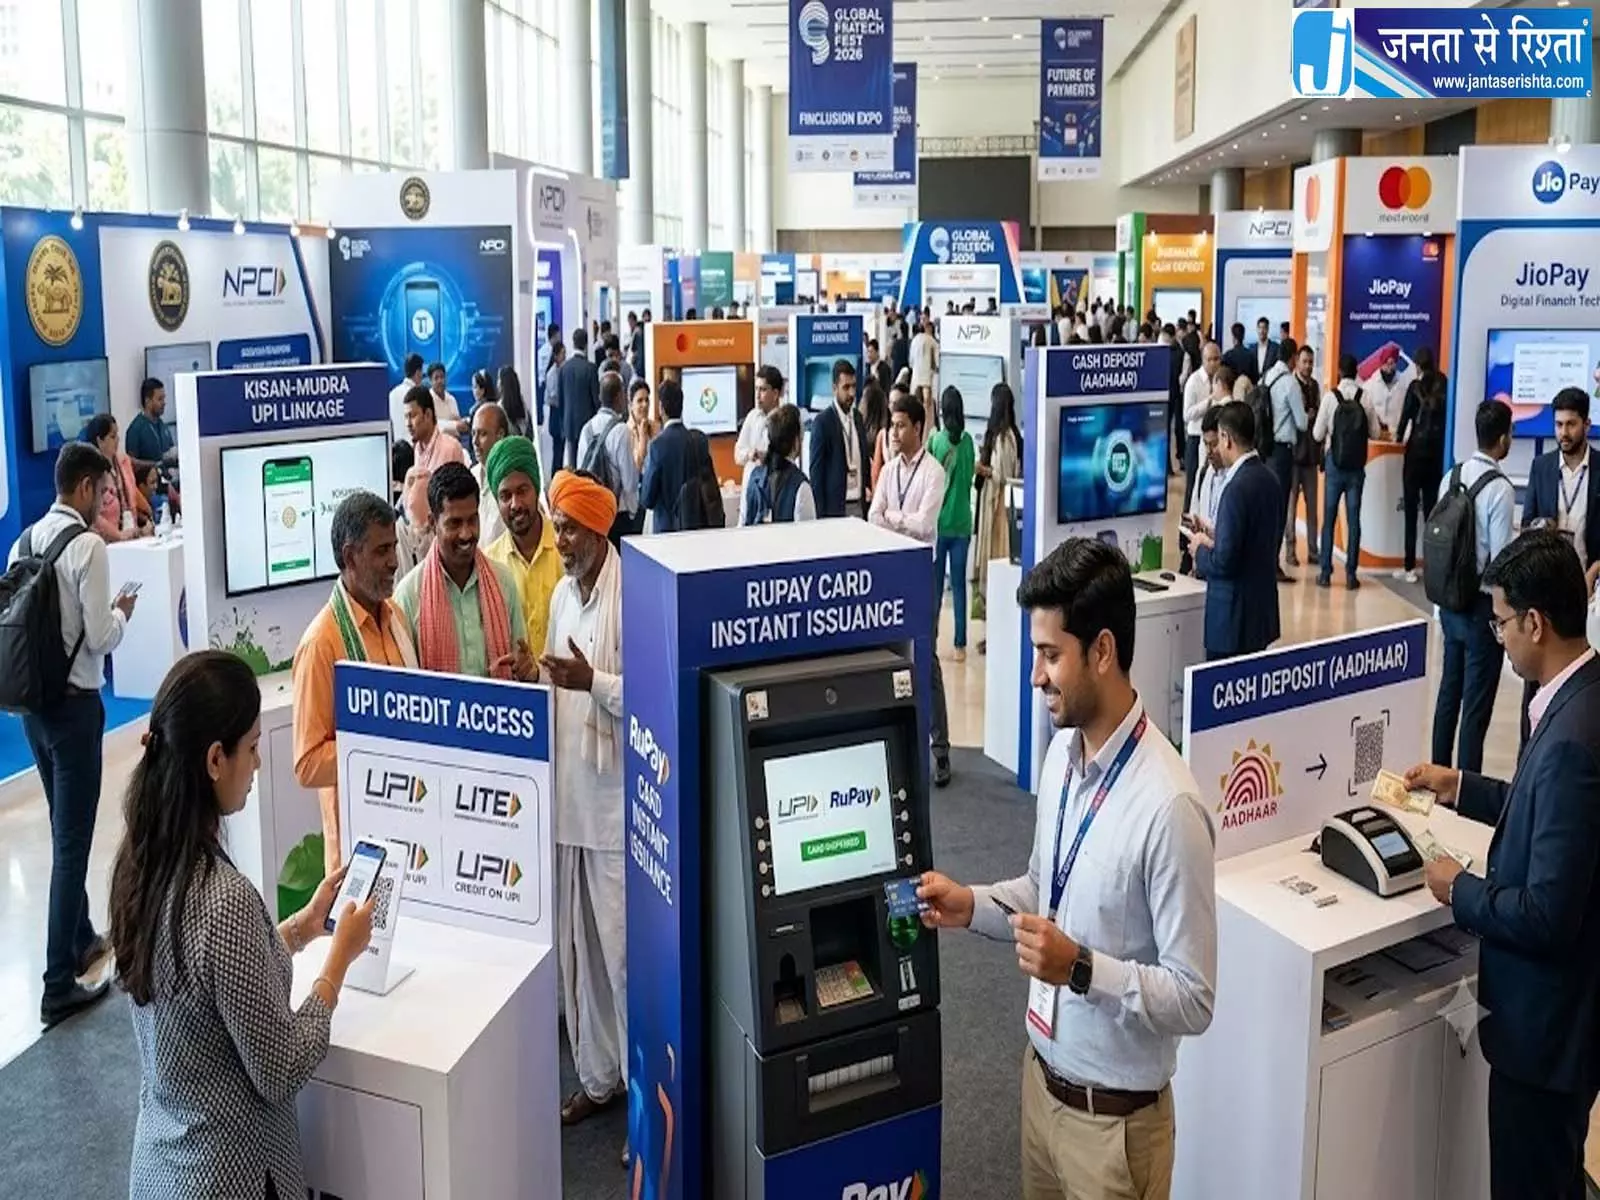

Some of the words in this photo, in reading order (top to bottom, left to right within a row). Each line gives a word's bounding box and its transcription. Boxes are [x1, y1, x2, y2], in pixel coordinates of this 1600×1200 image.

[834, 8, 882, 20] GLOBAL
[834, 35, 863, 46] FEST
[834, 48, 863, 61] 2026
[1047, 68, 1082, 82] FUTURE
[1083, 68, 1096, 81] OF
[856, 111, 882, 125] EXPO
[1536, 172, 1563, 192] Jio
[1569, 173, 1600, 195] Pay
[951, 229, 991, 241] GLOBAL
[223, 267, 277, 298] NPCI
[1515, 262, 1590, 292] JioPay
[1501, 295, 1533, 309] Digital
[1072, 354, 1101, 370] CASH
[1102, 352, 1146, 368] DEPOSIT
[244, 375, 350, 400] KISAN-MUDRA
[252, 403, 278, 423] UPI
[282, 398, 345, 421] LINKAGE
[747, 575, 814, 609] RUPAY
[818, 569, 872, 600] CARD
[711, 611, 801, 649] INSTANT
[807, 599, 904, 637] ISSUANCE
[1212, 680, 1256, 710] CASH
[1261, 660, 1326, 699] DEPOSIT
[1329, 640, 1409, 688] (AADHAAR)
[347, 686, 379, 717] UPI
[383, 690, 452, 726] CREDIT
[456, 701, 535, 739] ACCESS
[629, 714, 664, 786] RuPay
[365, 768, 417, 803] UPI
[455, 783, 511, 817] LITE
[778, 794, 810, 818] UPI
[830, 787, 874, 808] RuPay
[632, 798, 670, 864] INSTANT
[1221, 803, 1278, 831] AADHAAR
[456, 849, 510, 887] UPI
[455, 881, 487, 897] CREDIT
[489, 887, 503, 900] ON
